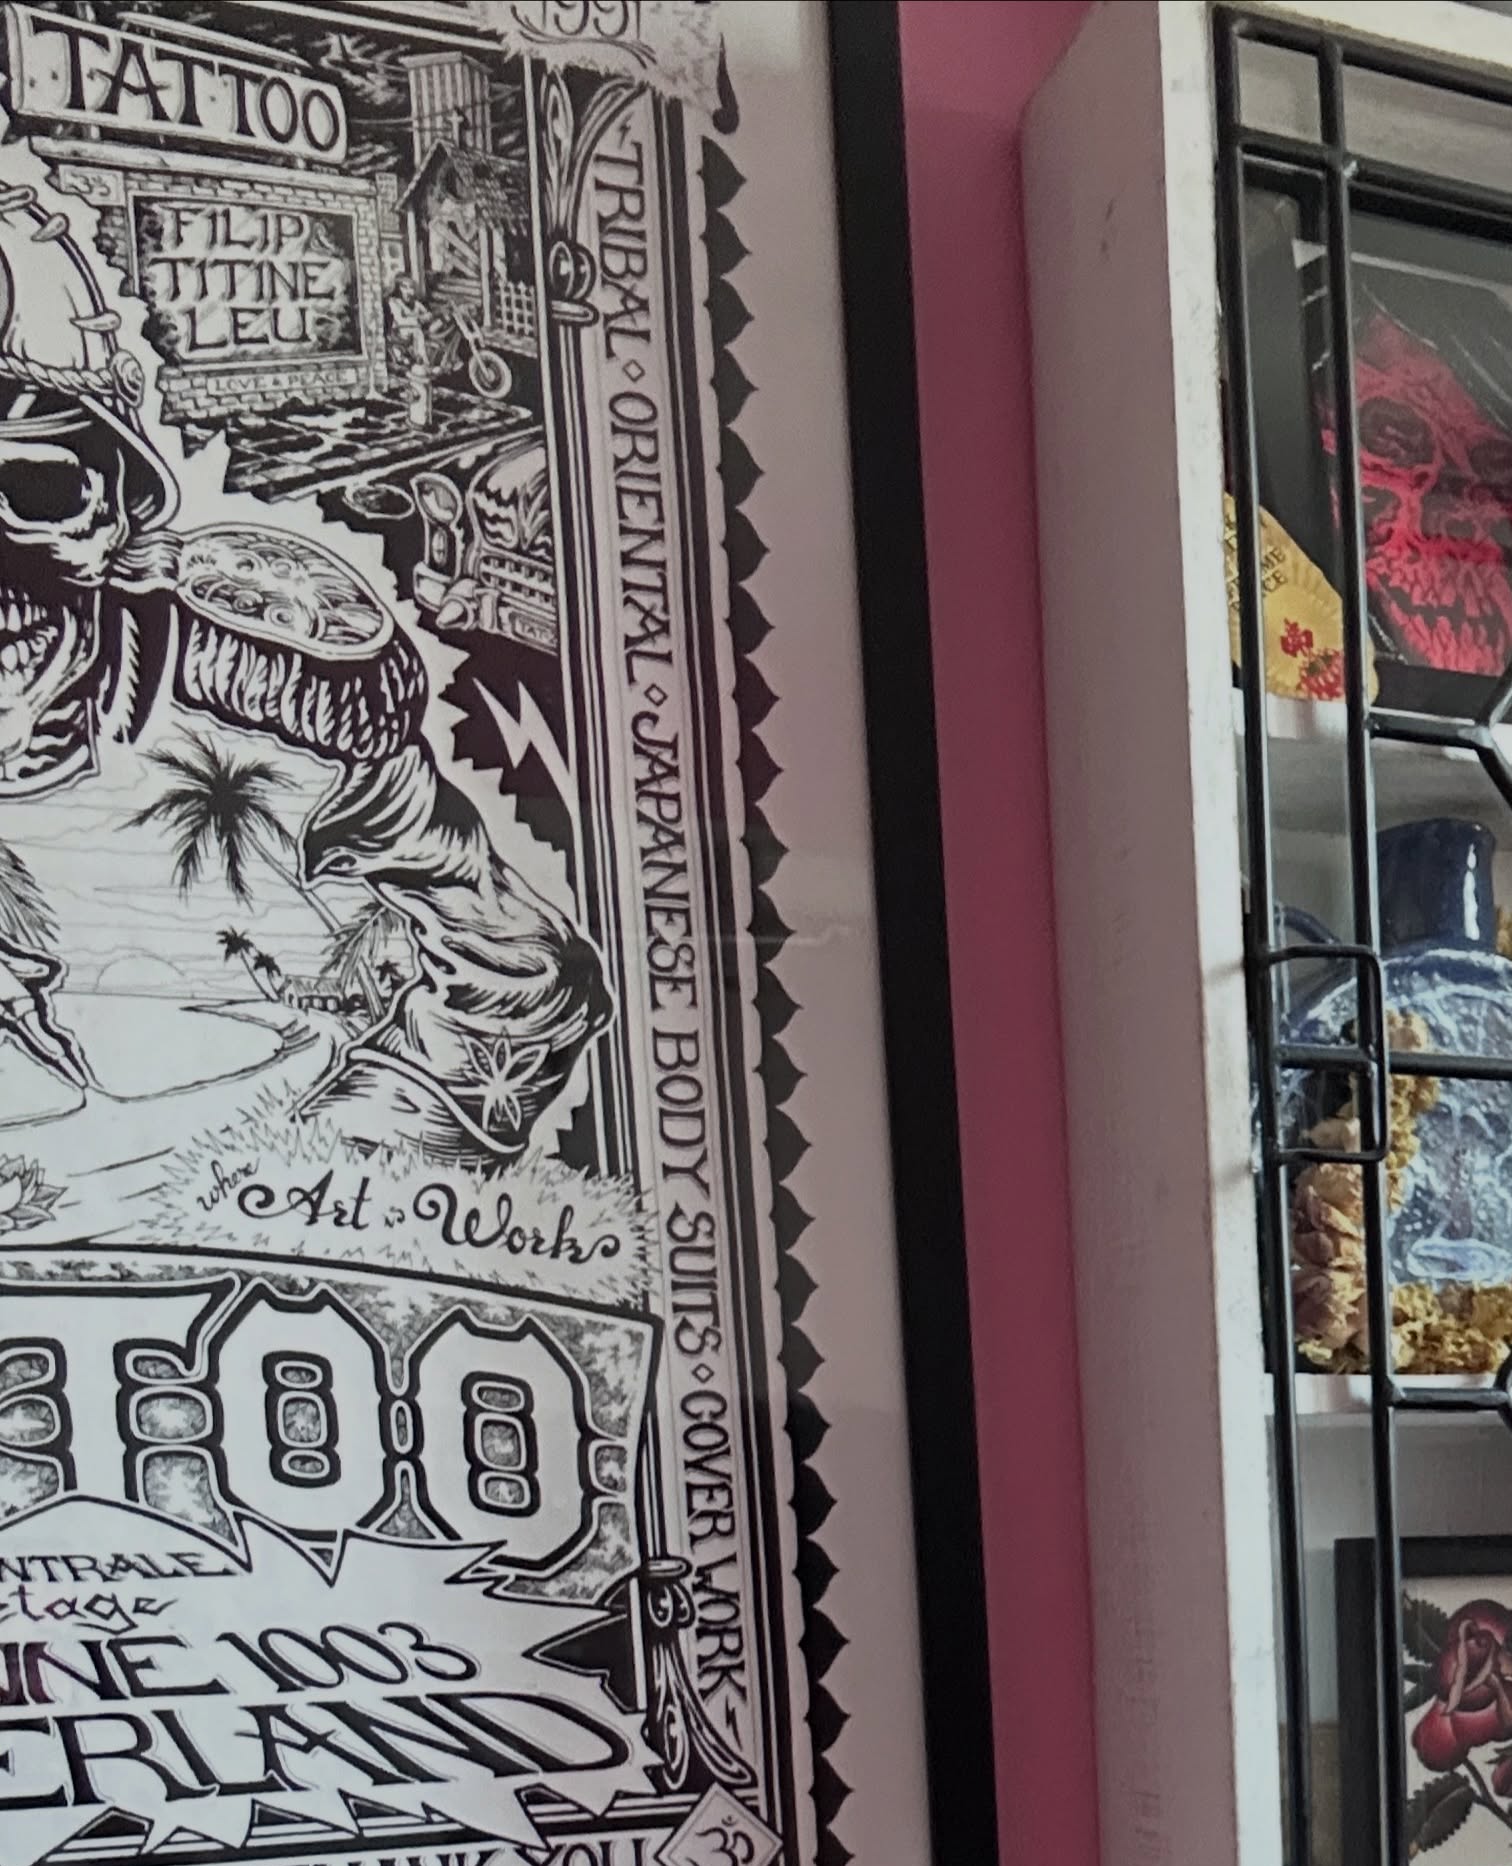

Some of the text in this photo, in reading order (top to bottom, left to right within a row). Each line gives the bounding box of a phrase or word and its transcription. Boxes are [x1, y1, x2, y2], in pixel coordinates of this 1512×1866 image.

[31, 15, 341, 152] TATTOO
[160, 205, 304, 254] FILIP
[150, 256, 336, 300] TITINE
[186, 306, 313, 353] LEU
[215, 375, 267, 391] LOVE
[288, 370, 348, 386] PEACE
[594, 140, 748, 1702] TRIBAL ORIENTAL JAPANESE BODY SUITS COVER WORK
[237, 1168, 373, 1230] Art
[0, 1552, 237, 1582] NTRALE
[0, 1584, 179, 1635] tage
[216, 1621, 479, 1693] 1003
[0, 1692, 632, 1809] ERLAND
